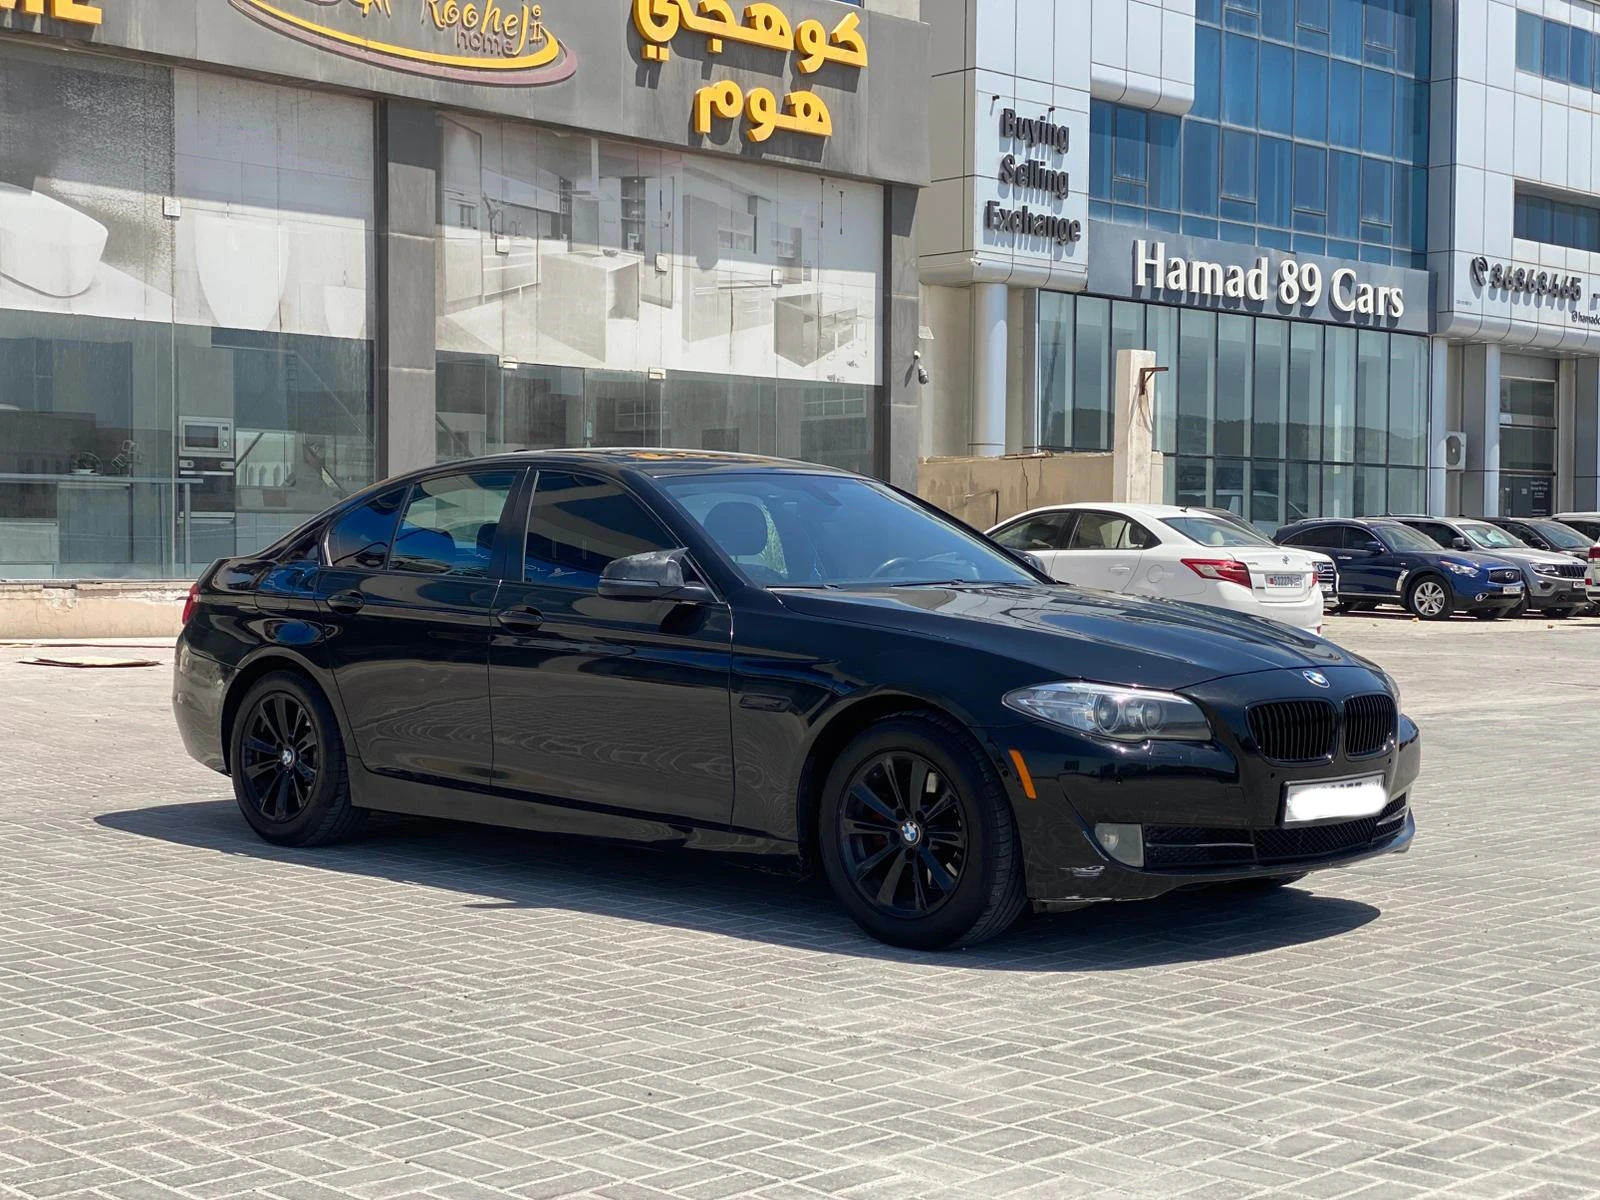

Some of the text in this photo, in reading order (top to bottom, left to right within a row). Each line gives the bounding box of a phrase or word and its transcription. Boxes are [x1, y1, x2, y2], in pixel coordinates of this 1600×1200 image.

[632, 0, 868, 73] كوهجي
[694, 80, 832, 142] هوم
[1002, 107, 1070, 154] Buying
[1000, 154, 1069, 199] Selling
[986, 200, 1081, 246] Exchange
[1134, 239, 1404, 318] Hamad 89 Cars
